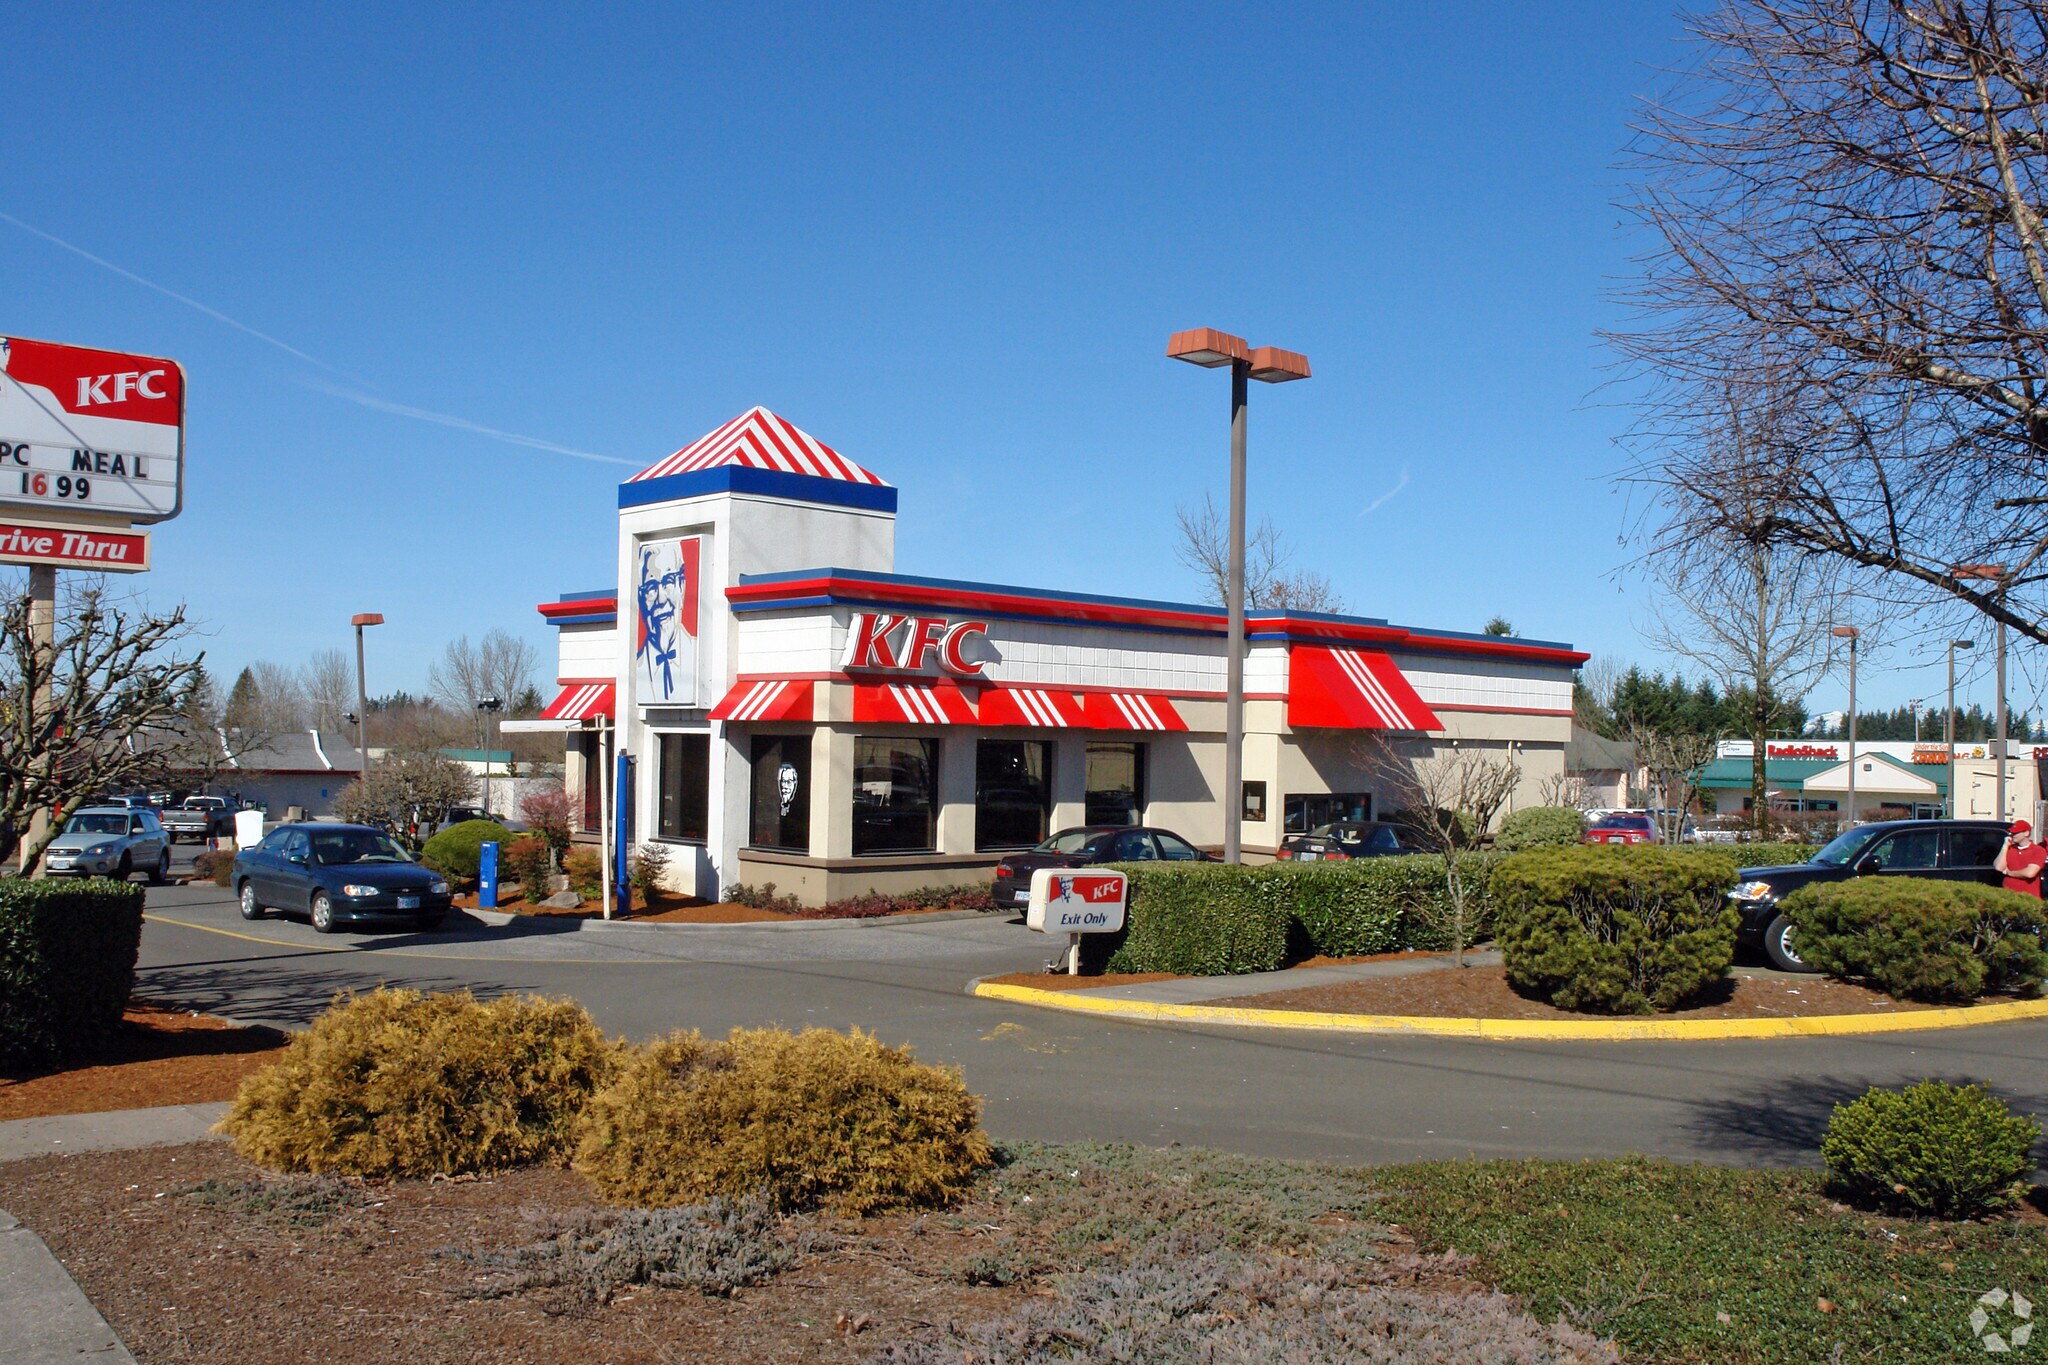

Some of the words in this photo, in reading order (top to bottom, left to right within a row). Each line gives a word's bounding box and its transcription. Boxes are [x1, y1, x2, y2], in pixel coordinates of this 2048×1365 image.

[76, 369, 167, 407] KFC
[0, 442, 30, 466] PC
[72, 449, 147, 478] MEAL
[61, 533, 128, 560] Thru
[849, 612, 989, 675] KFC
[1767, 745, 1838, 757] RadioShack
[1911, 751, 1969, 765] TANN
[1093, 880, 1118, 900] KFC
[1061, 913, 1081, 925] Exit
[1084, 912, 1108, 926] Only
